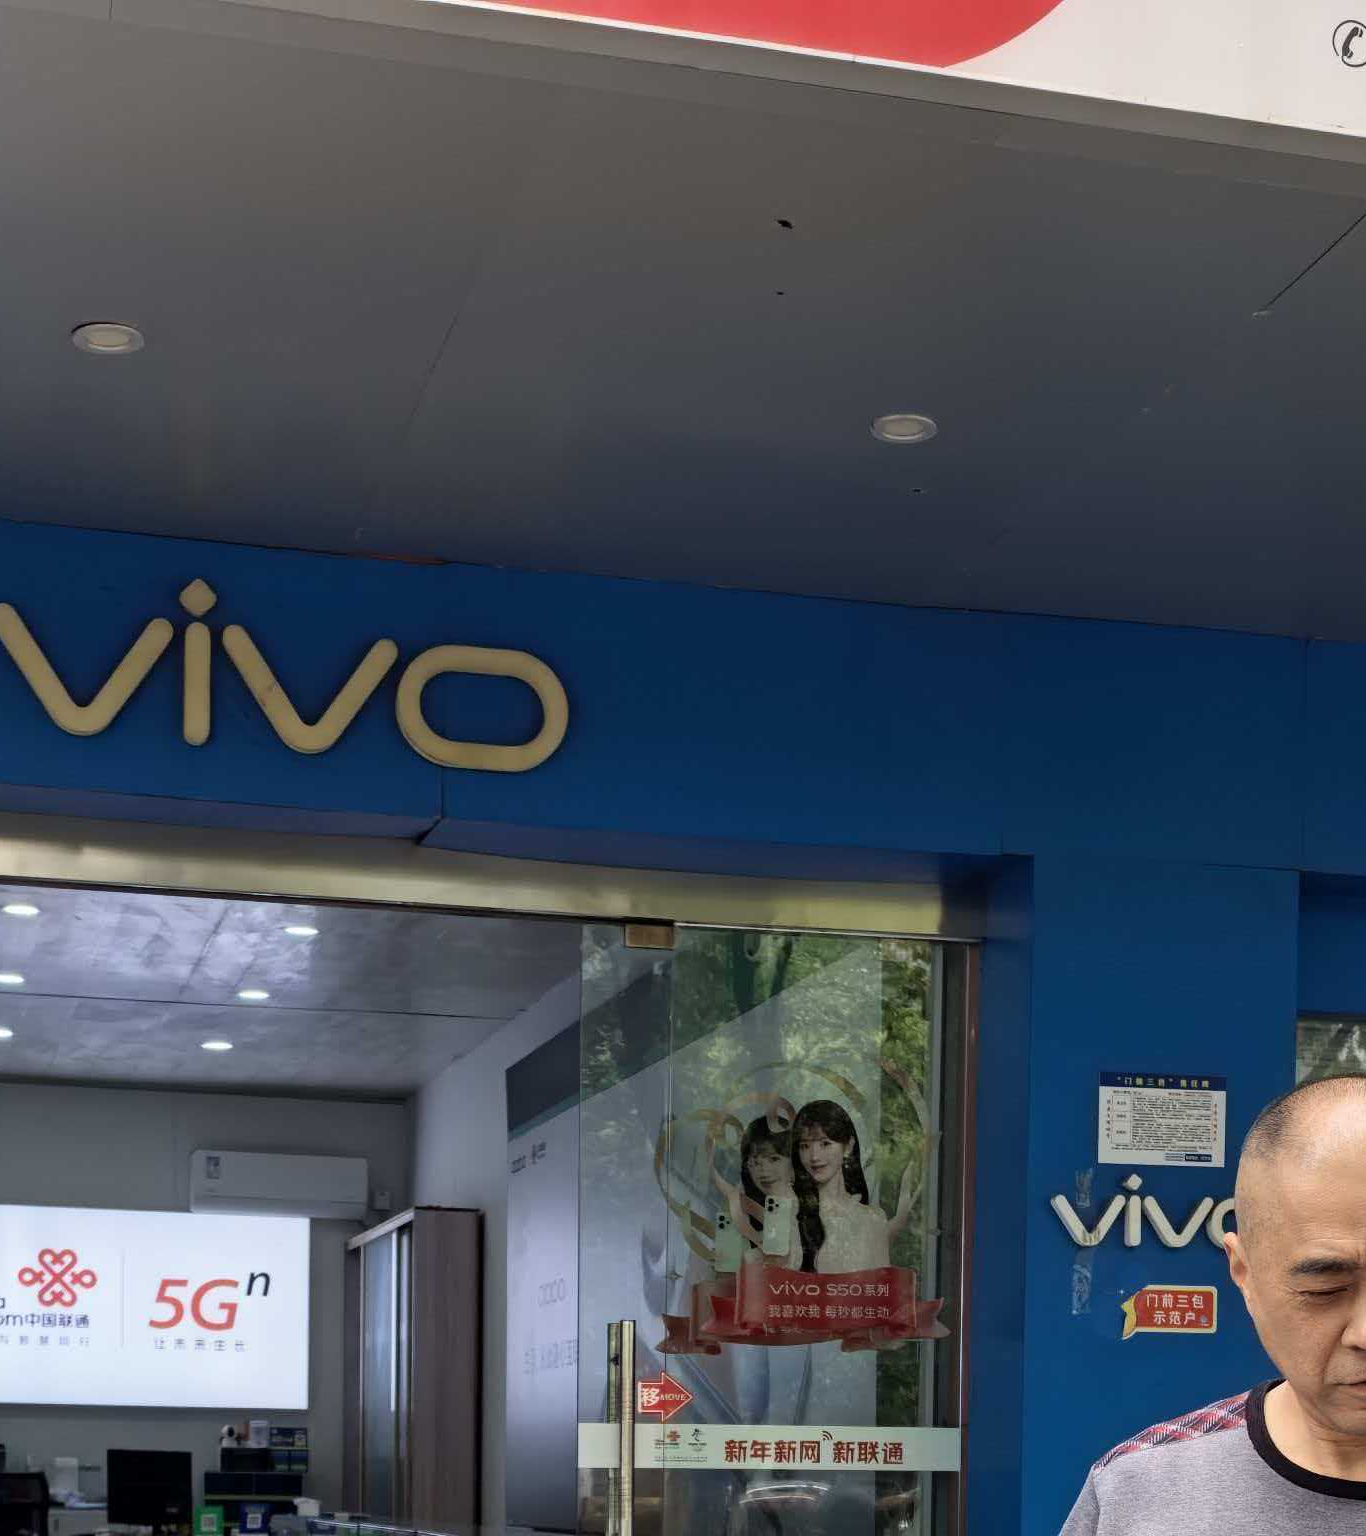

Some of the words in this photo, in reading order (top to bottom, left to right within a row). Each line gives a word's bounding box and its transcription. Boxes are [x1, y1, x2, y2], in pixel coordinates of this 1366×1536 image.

[769, 1283, 820, 1297] vivo
[826, 1284, 862, 1297] S50
[864, 1284, 890, 1297] 系列
[1145, 1293, 1204, 1309] 门前三包
[1152, 1311, 1196, 1325] 示范户
[724, 1439, 821, 1465] 新年新网
[832, 1440, 904, 1466] 新联通
